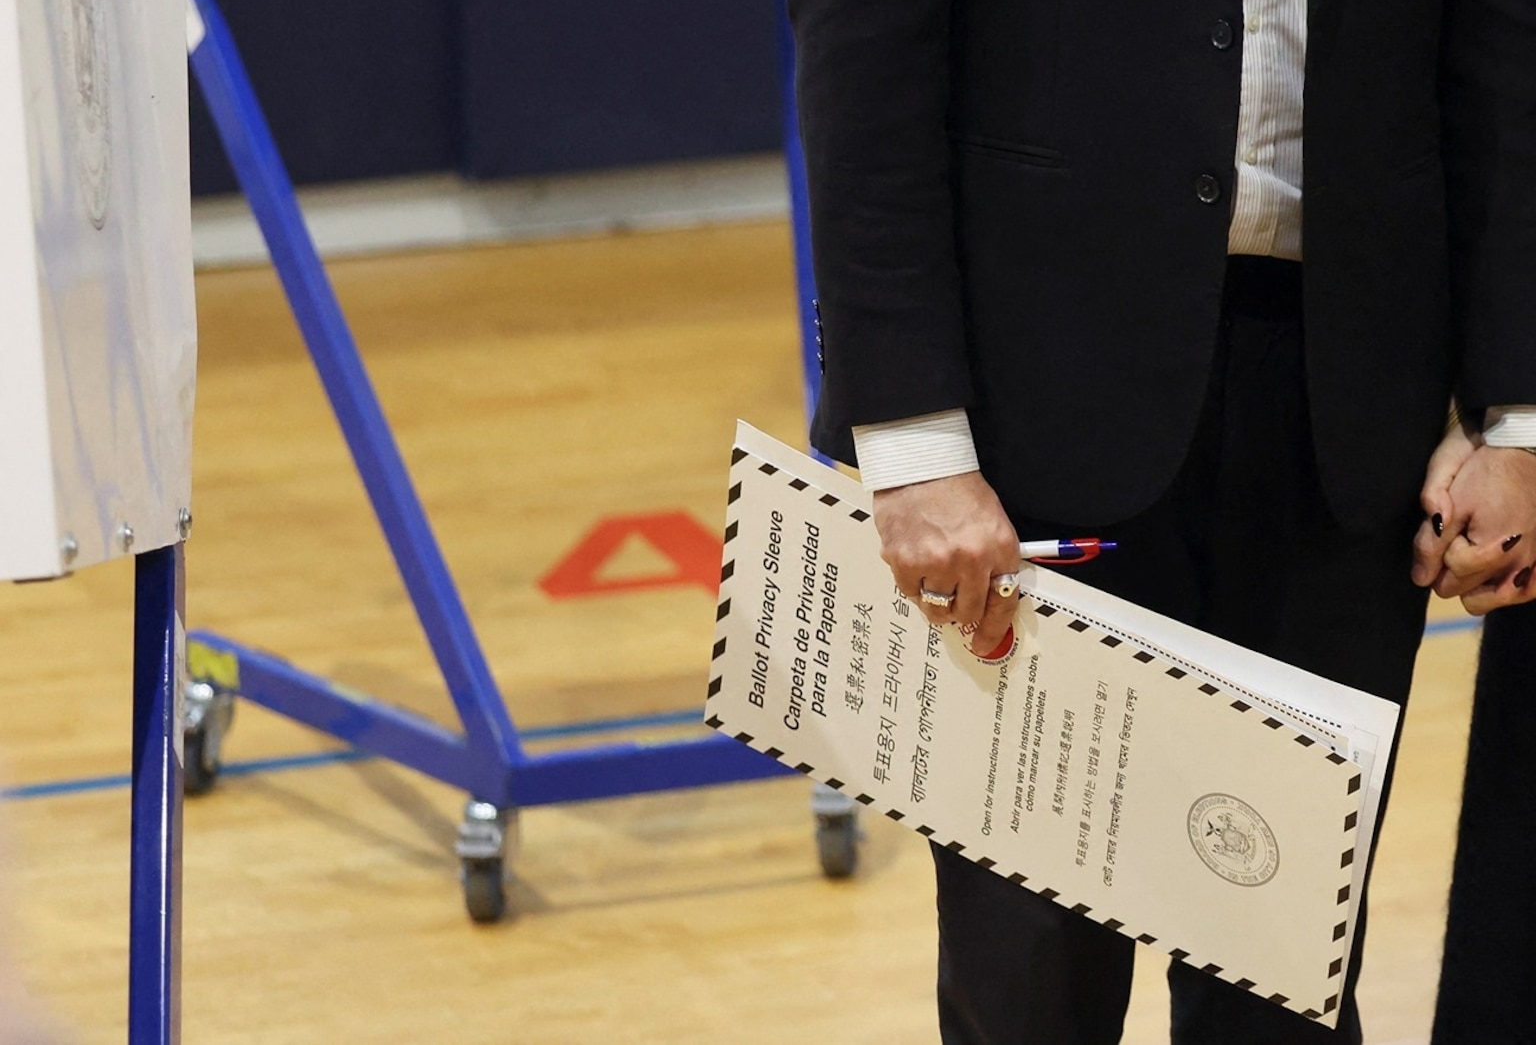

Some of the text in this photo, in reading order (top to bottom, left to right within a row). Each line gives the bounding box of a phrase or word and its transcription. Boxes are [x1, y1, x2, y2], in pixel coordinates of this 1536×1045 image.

[747, 509, 783, 709] Ballot Privacy Sleeve
[782, 520, 820, 731] Carpeta de Privacidad
[810, 561, 839, 718] para la Papeleta
[843, 602, 874, 715] 選票私密票夾
[881, 620, 908, 713] 프라이버시
[872, 714, 897, 785] 투표용지
[914, 662, 939, 742] গোপনীয়তা
[979, 662, 1009, 836] Open for instructions on marking yo
[1009, 653, 1039, 834] Abrir para ver las instrucciones sobre
[1023, 688, 1047, 812] cómo marcar su papeleta.
[909, 745, 930, 803] ব্যালটের
[1074, 679, 1109, 867] 투표용지를 표시하는 방법을 보시려면 열기
